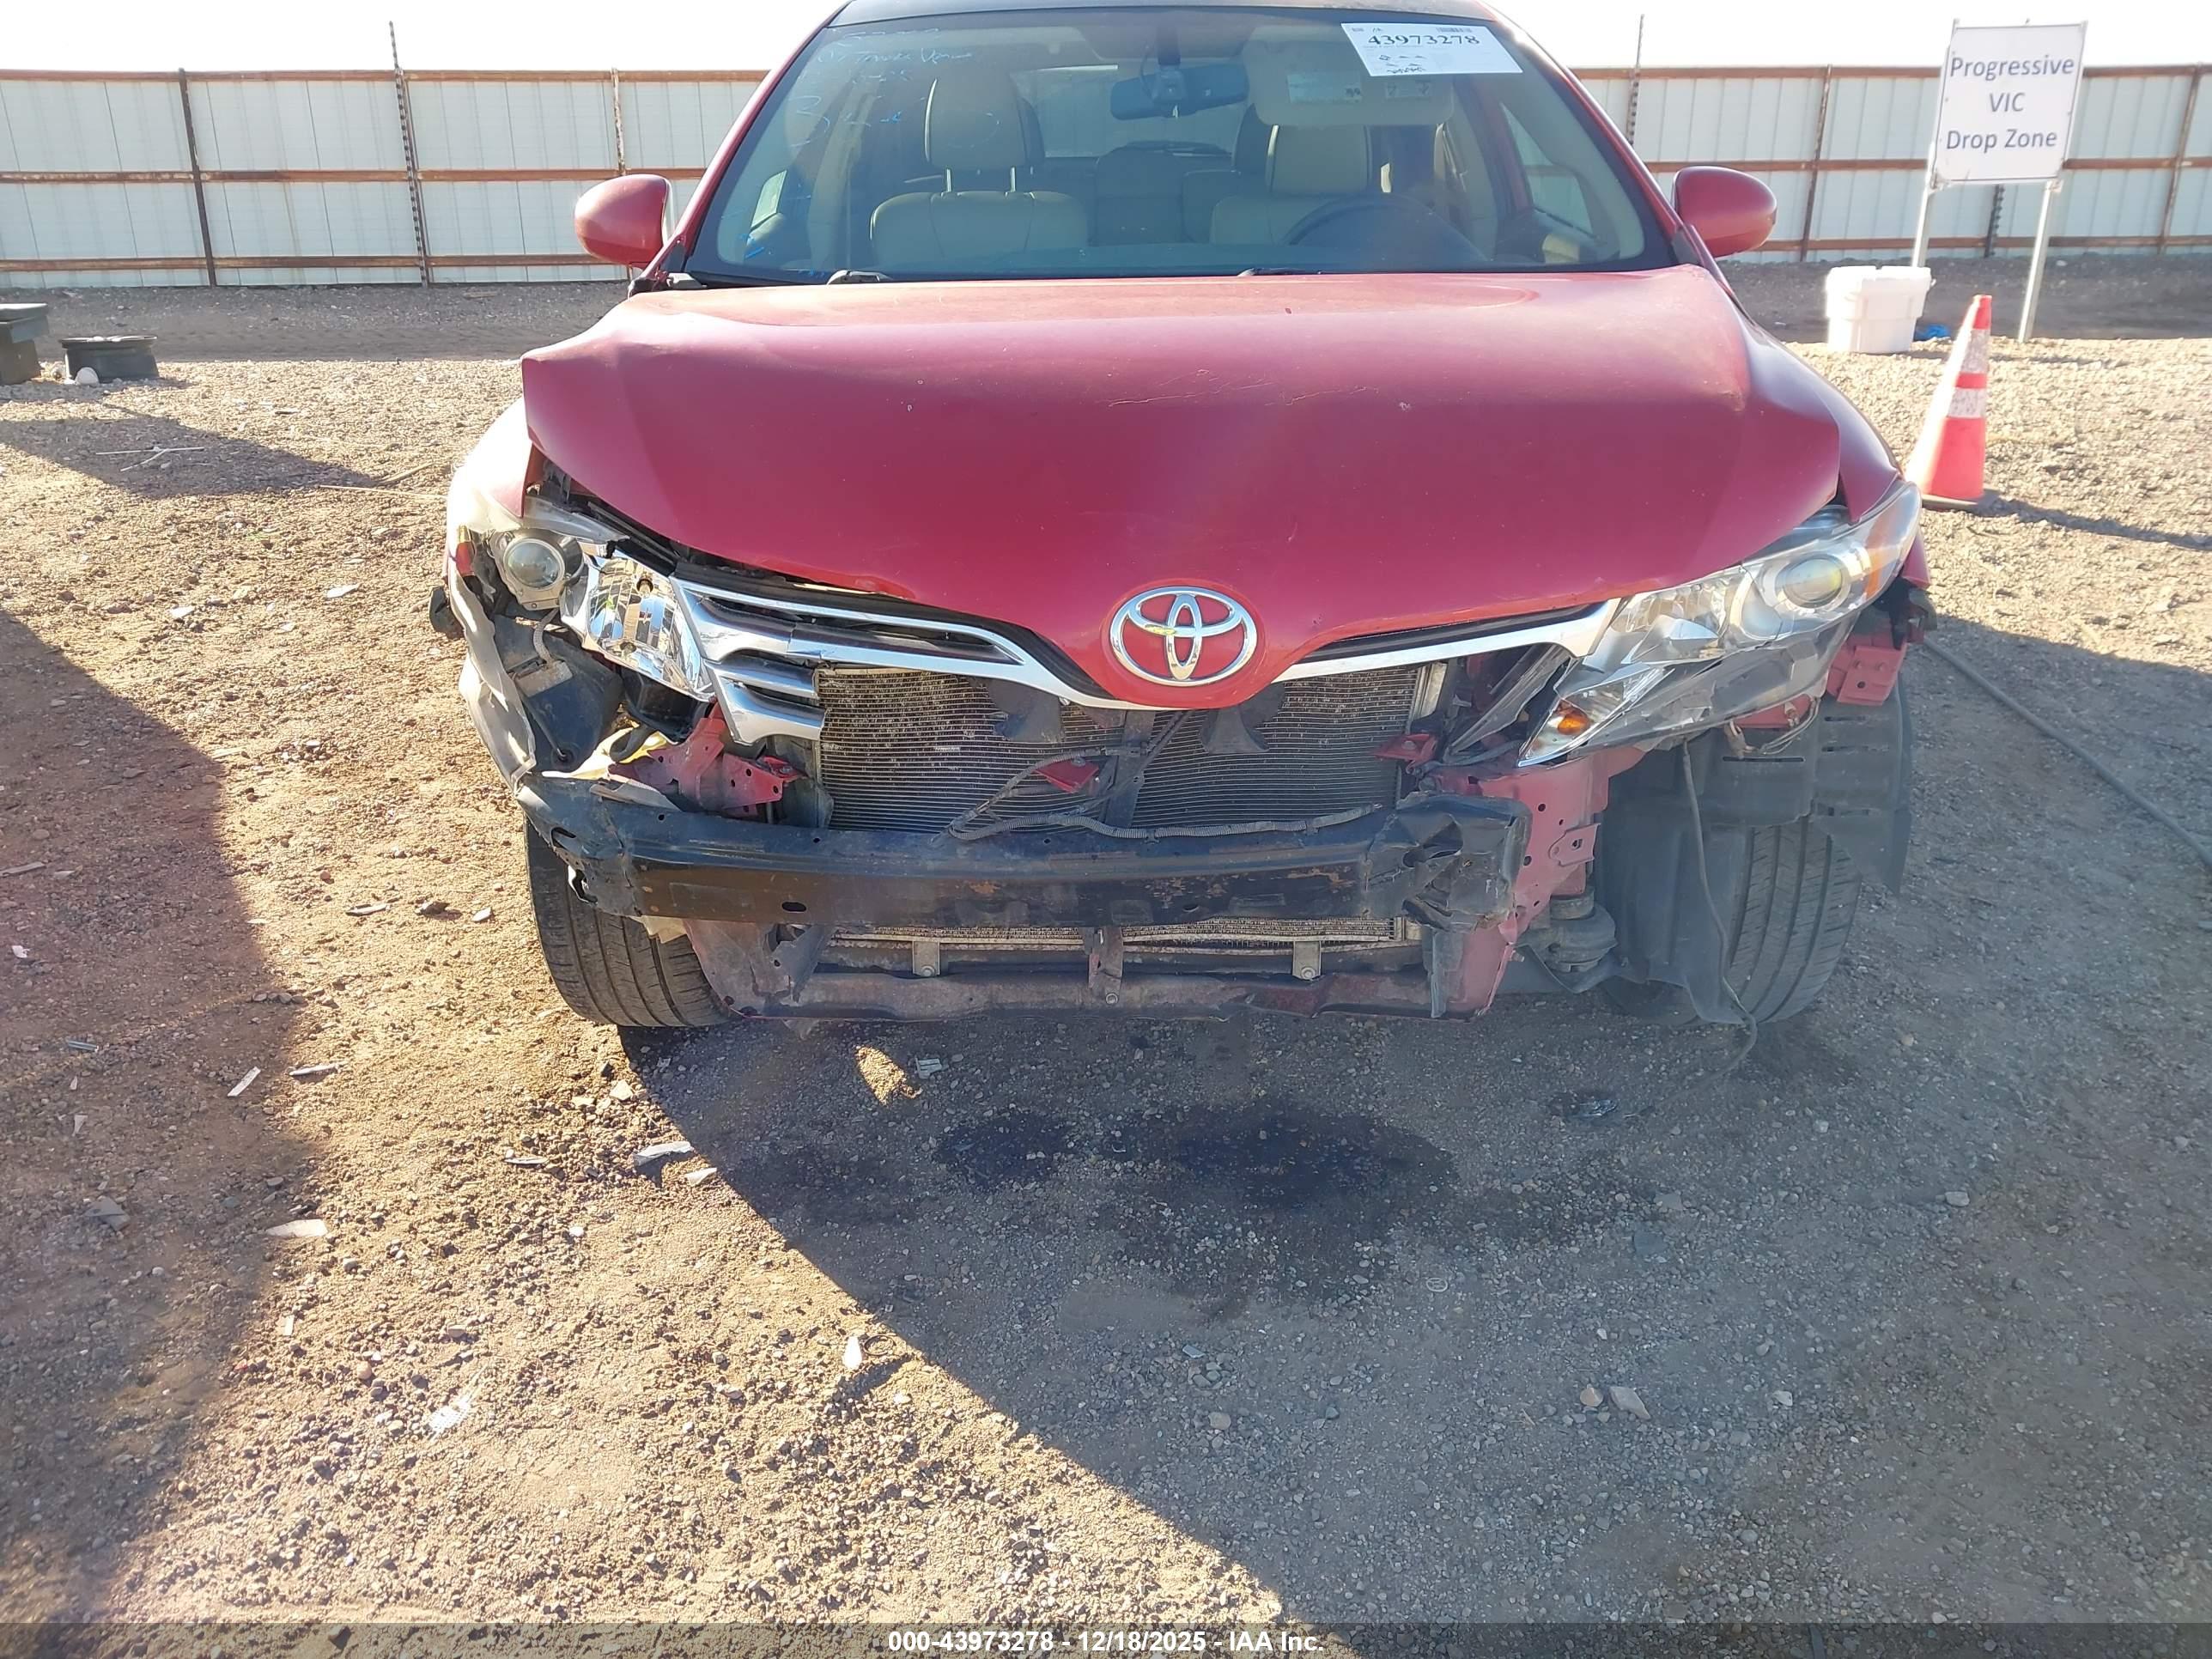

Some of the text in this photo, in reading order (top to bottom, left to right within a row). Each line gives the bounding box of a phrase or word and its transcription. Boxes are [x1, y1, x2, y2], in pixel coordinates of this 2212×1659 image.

[1368, 34, 1480, 45] 43973278
[1950, 55, 2075, 81] Progressive
[1990, 92, 2025, 112] VIC
[1947, 130, 2057, 154] Drop Zone
